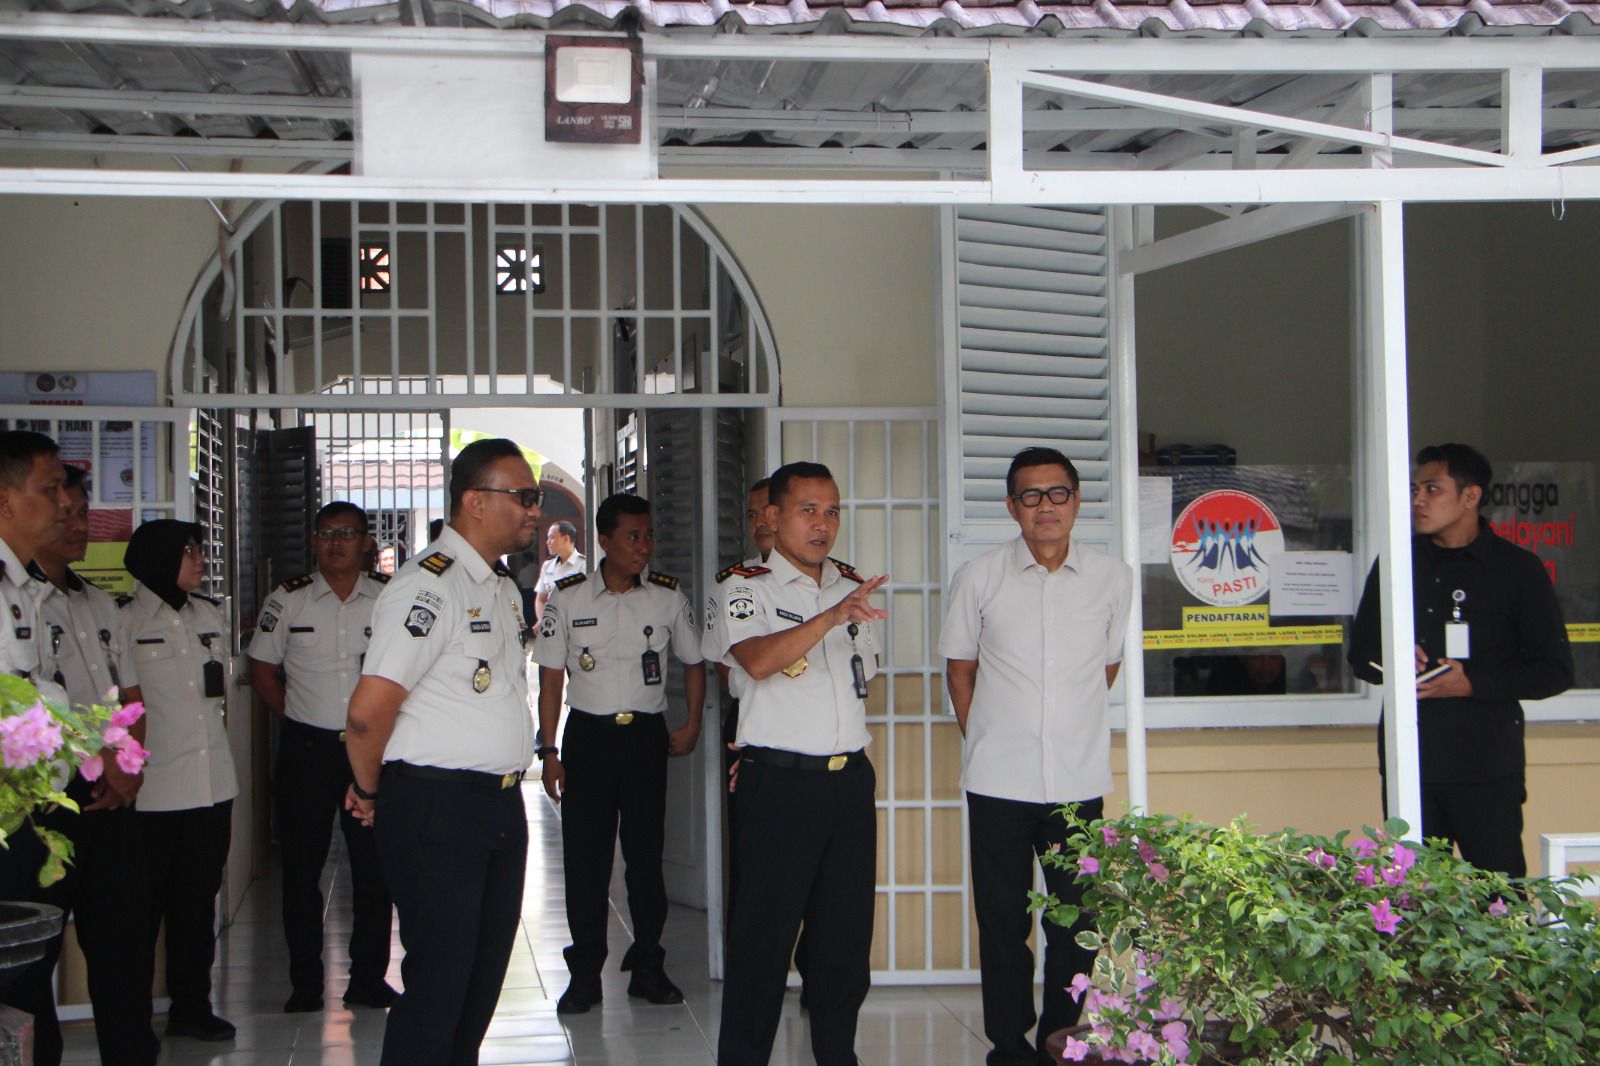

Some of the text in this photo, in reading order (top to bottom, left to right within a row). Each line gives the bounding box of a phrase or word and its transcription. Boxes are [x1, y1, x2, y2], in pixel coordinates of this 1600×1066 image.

[1482, 482, 1558, 514] angga
[1212, 576, 1257, 597] PASTI
[1187, 613, 1265, 622] PENDAFTARAN
